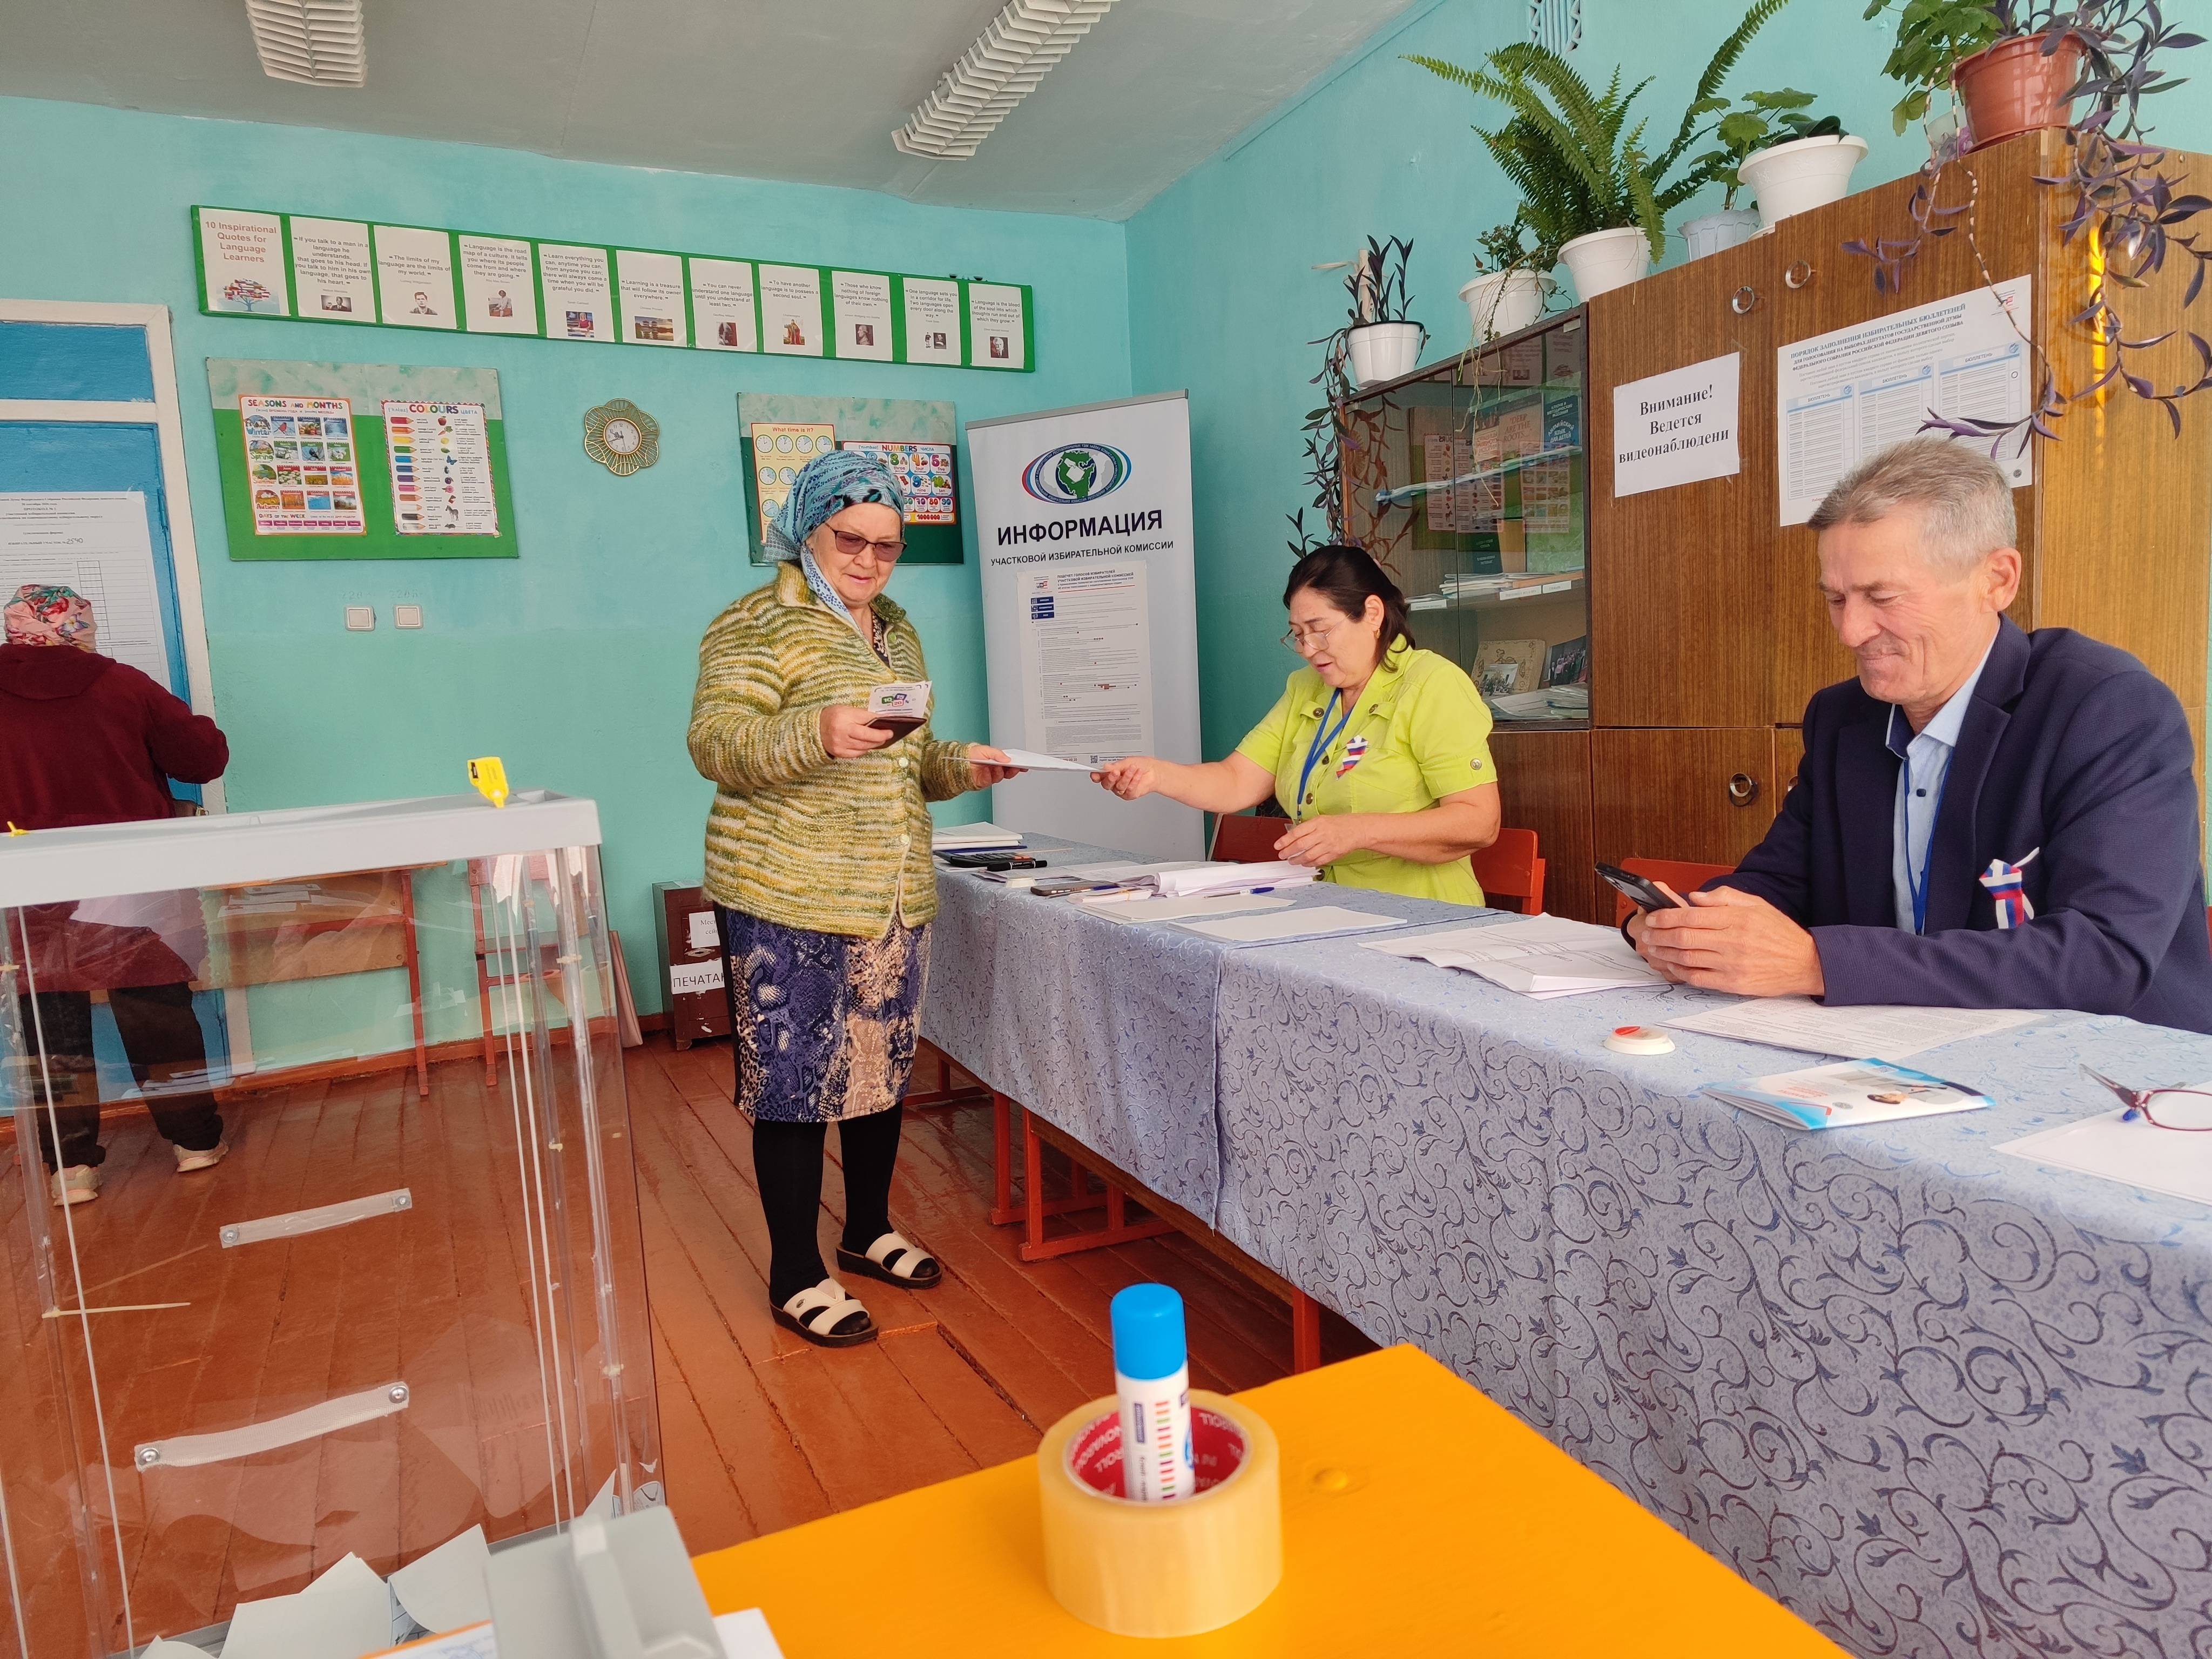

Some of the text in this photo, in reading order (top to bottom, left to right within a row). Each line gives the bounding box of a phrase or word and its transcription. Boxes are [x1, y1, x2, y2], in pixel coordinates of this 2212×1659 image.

[219, 222, 276, 234] Inspirational
[217, 232, 251, 241] Quotes
[220, 242, 266, 254] Language
[313, 245, 341, 253] language
[224, 253, 265, 262] Learners
[1791, 304, 1965, 359] ПОРЯДОК ЗАПОЛНЕНИЯ ИЗБИРАТЕЛЬНЫХ БЮЛЛЕТЕНЕЙ
[1803, 349, 1836, 362] ГОЛОСОВАНИЯ
[1844, 340, 1866, 350] ВЫБОРАХ
[1866, 333, 1894, 345] ДЕПУТАТОВ
[1894, 318, 1945, 336] ГОСУДАРСТВЕННОЙ
[1945, 313, 1962, 322] ДУМЫ
[1792, 321, 1964, 371] ФЕДЕРАЛЬНОГО СОБРАНИЯ РОССИЙСКОЙ ФЕДЕРАЦИИ ДЕВЯТОГО СОЗЫВА
[1965, 353, 1992, 362] БЮЛЛЕТЕНЬ
[1883, 374, 1907, 383] БЮЛЛЕТЕНЬ
[1640, 385, 1712, 416] Внимание!
[1808, 393, 1830, 402] БЮЛЛЕТЕНЬ
[307, 401, 342, 409] MONTHS
[409, 404, 458, 414] COLOURS
[1517, 421, 1530, 429] THE
[1650, 414, 1702, 435] Ведется
[1619, 429, 1729, 463] видеонаблюдени
[250, 453, 274, 462] Spring
[890, 453, 940, 467] 3 4 5
[913, 476, 921, 488] 9
[997, 509, 1162, 545] ИНФОРМАЦИЯ
[991, 541, 1174, 566] УЧАСТКОВОЙ ИЗБИРАТЕЛЬНОЙ КОМИССИИ
